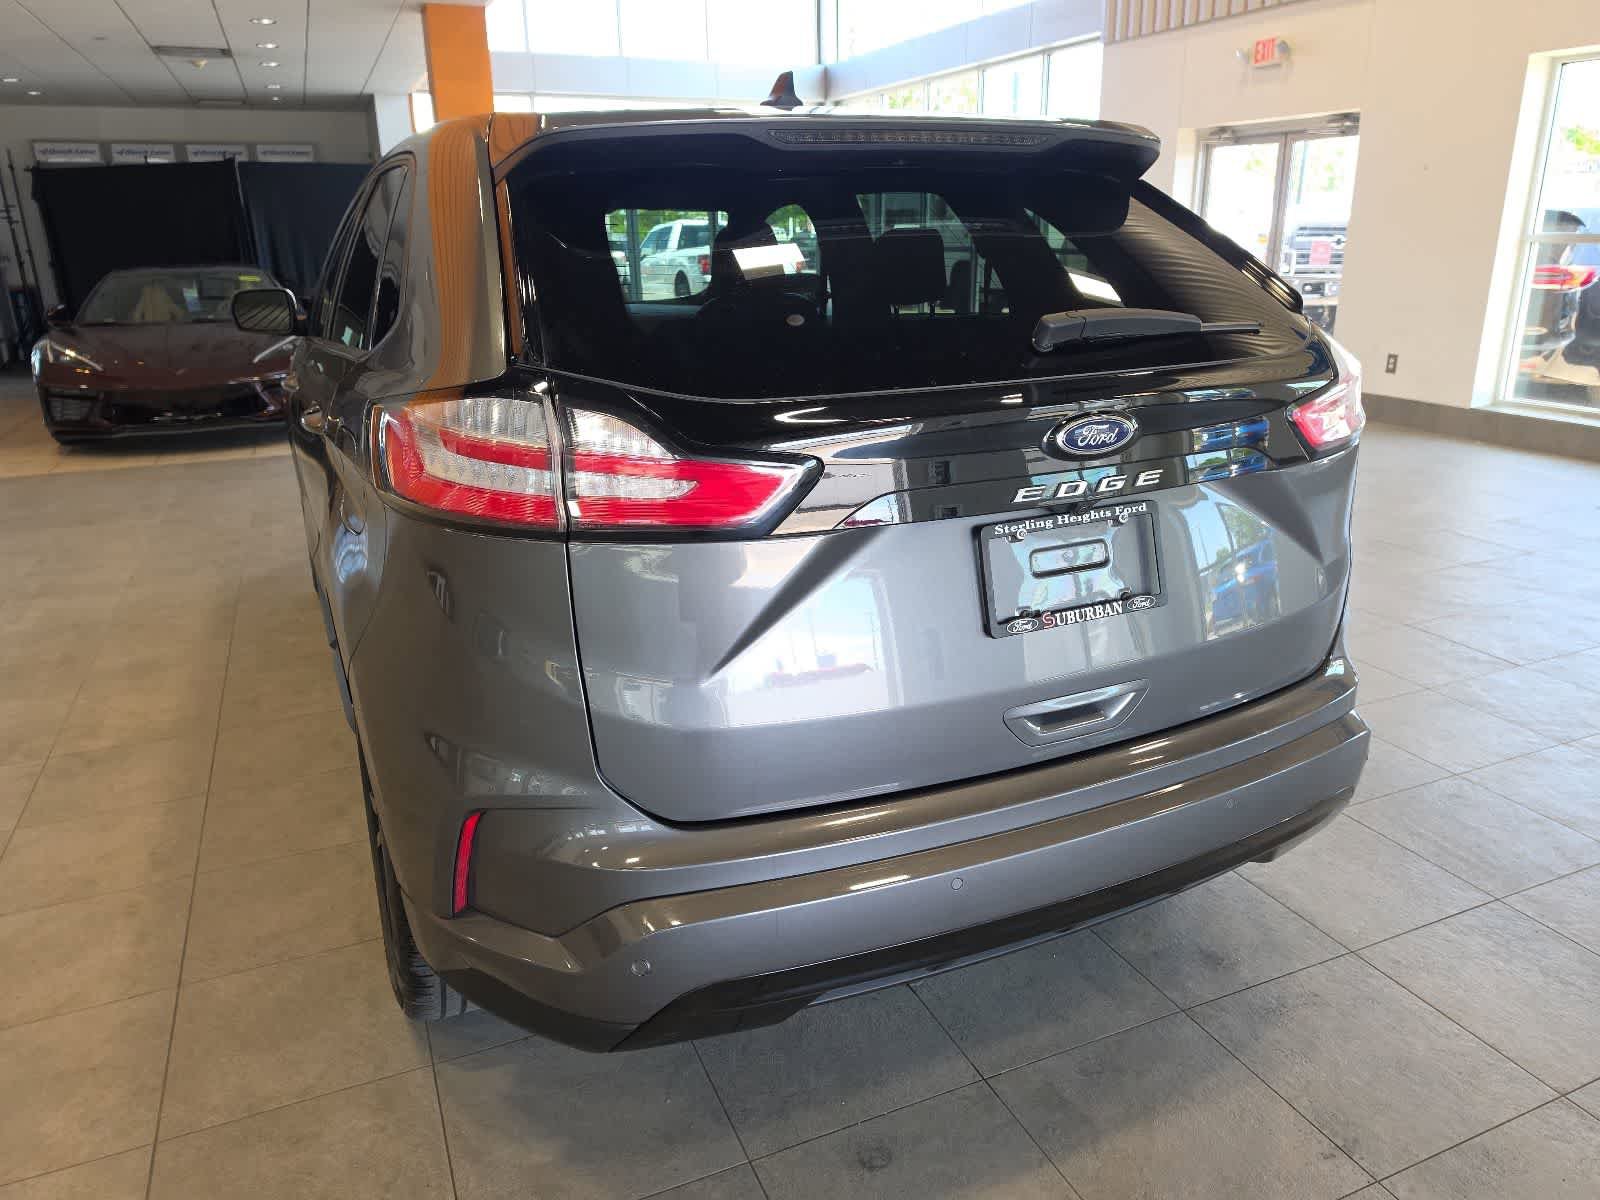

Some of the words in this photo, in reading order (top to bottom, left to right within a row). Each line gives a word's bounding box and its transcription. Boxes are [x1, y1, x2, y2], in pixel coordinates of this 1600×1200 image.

[1254, 38, 1277, 64] EXIT
[1078, 424, 1117, 446] Ford
[1013, 469, 1163, 503] EDGE
[994, 519, 1054, 535] Sterling
[1057, 509, 1112, 525] Heights
[1115, 502, 1147, 517] Ford
[1042, 601, 1123, 629] SUBURBAN
